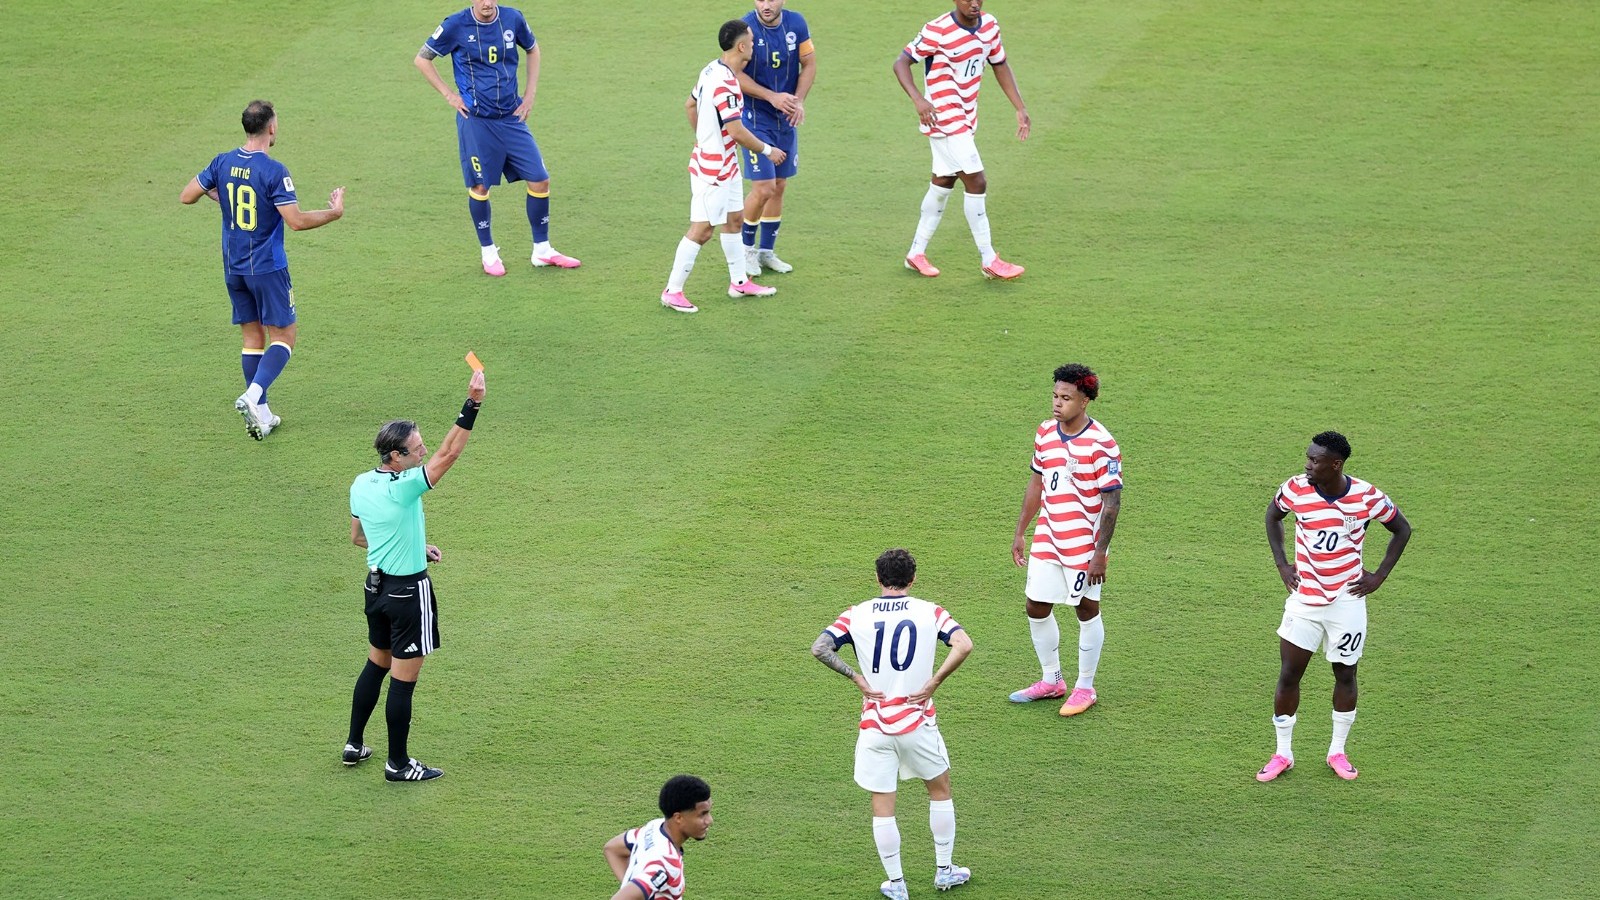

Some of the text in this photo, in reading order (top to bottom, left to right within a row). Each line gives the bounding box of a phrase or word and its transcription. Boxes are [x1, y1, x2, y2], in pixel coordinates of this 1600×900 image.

[488, 46, 498, 64] 6
[772, 51, 781, 69] 5
[964, 59, 979, 77] 16
[471, 156, 482, 172] 6
[226, 182, 257, 231] 18
[1050, 471, 1059, 491] 8
[1313, 530, 1339, 552] 20
[1074, 571, 1086, 592] 8
[872, 601, 910, 613] PULISIC
[872, 619, 917, 673] 10
[1337, 632, 1362, 652] 20
